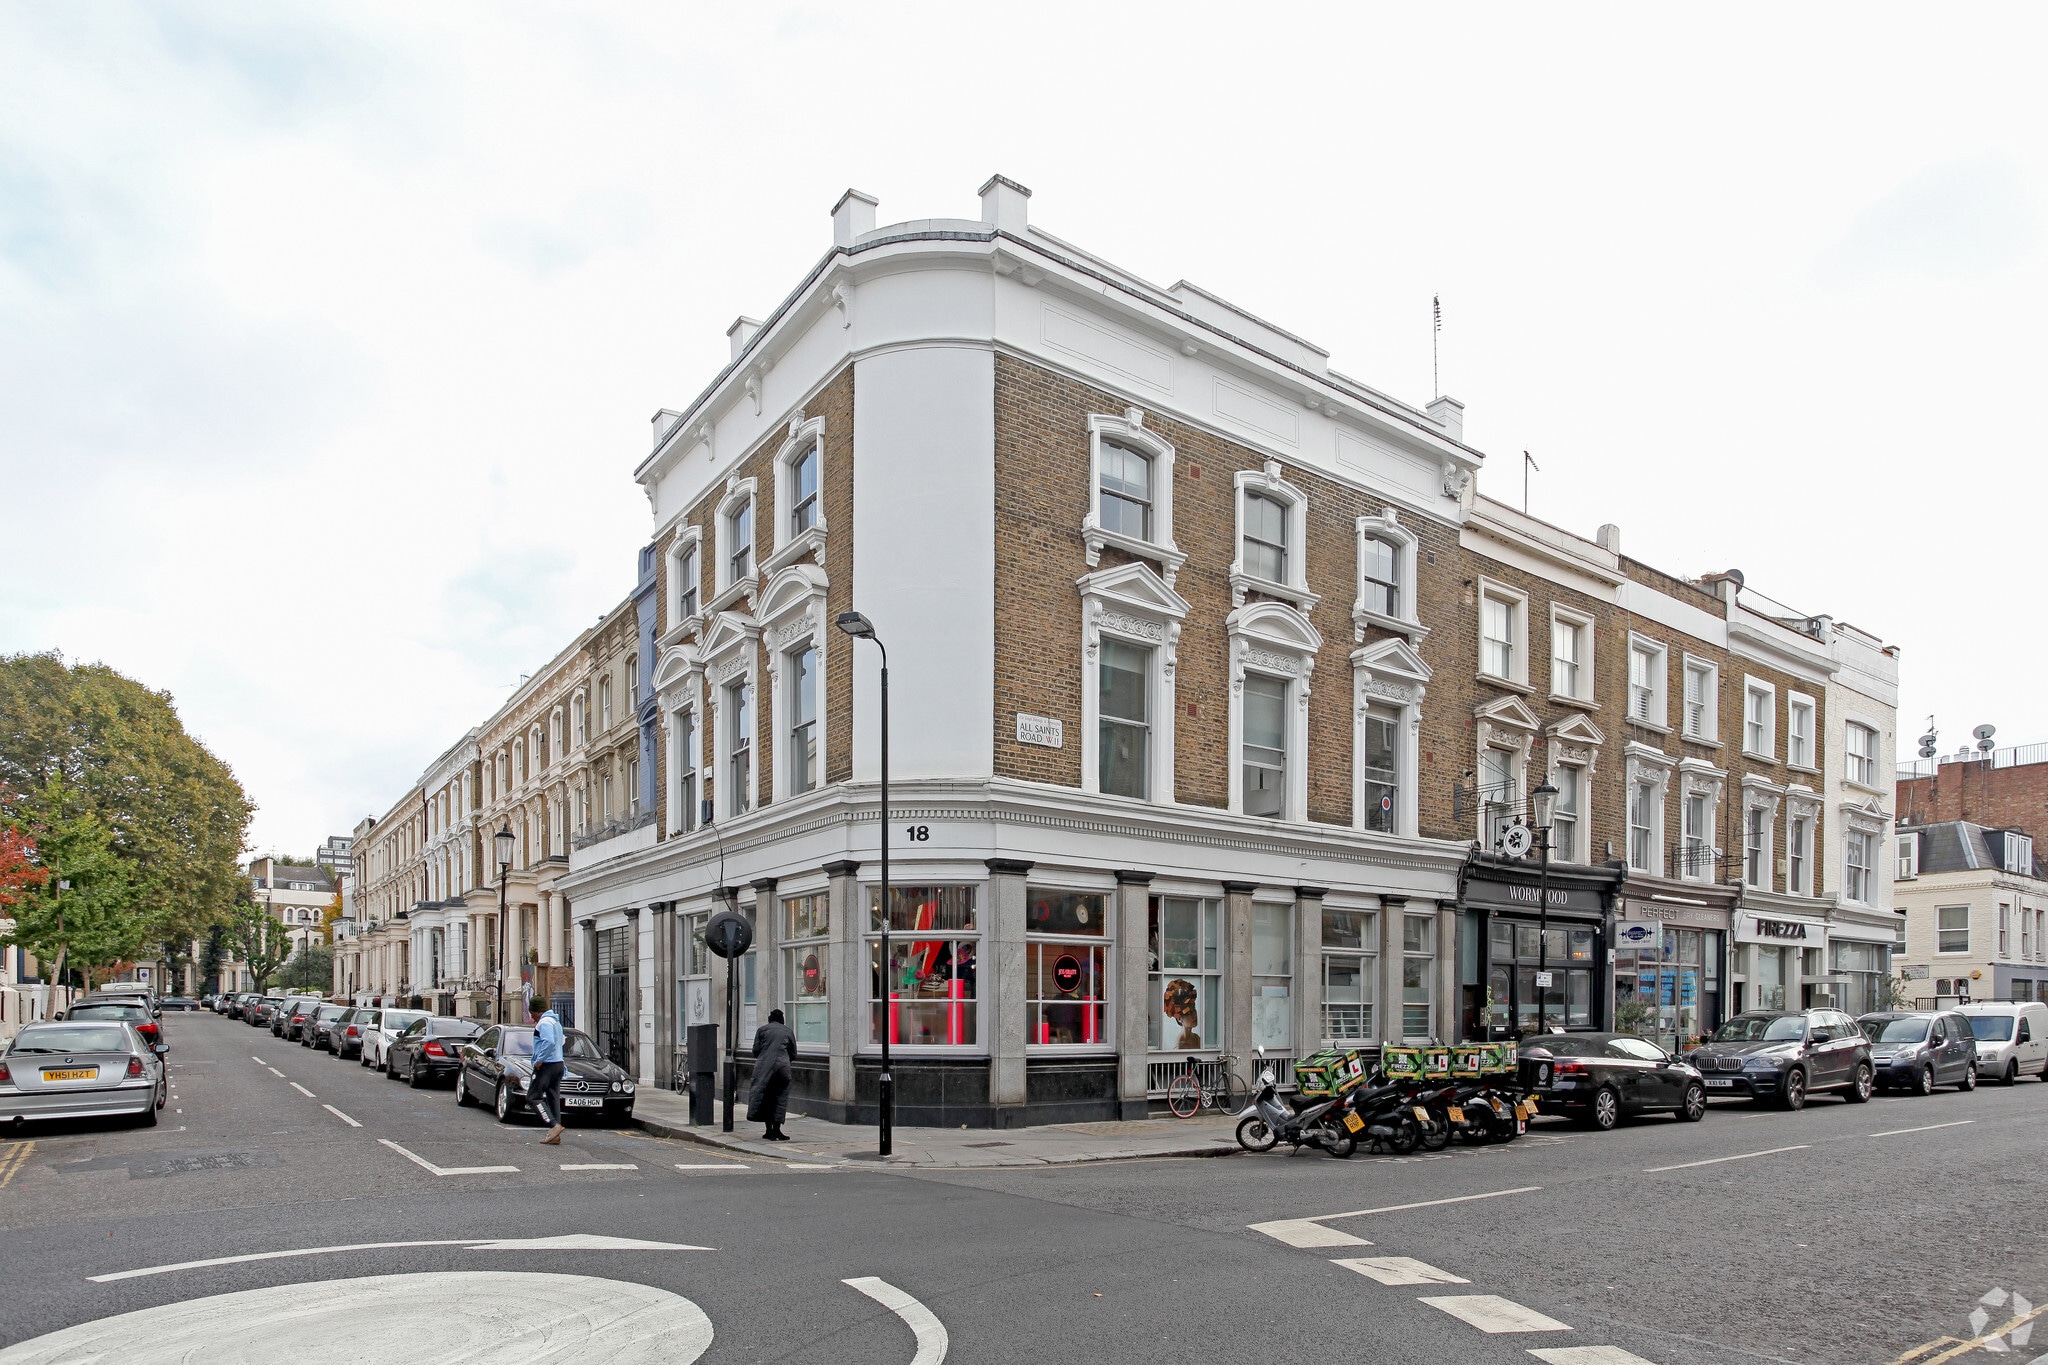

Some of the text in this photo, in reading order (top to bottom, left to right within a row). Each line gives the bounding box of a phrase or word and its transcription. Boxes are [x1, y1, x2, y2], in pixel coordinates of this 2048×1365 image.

[1020, 722, 1059, 737] ALL SAINTS
[907, 825, 930, 841] 18
[1641, 906, 1720, 922] PERFECT DRY CLEANERS
[1757, 918, 1807, 940] FIREZZA
[1441, 1058, 1446, 1068] L
[1470, 1057, 1476, 1068] L
[49, 1070, 91, 1079] YH51 HZT
[1351, 1064, 1359, 1074] L
[1520, 1120, 1525, 1131] L
